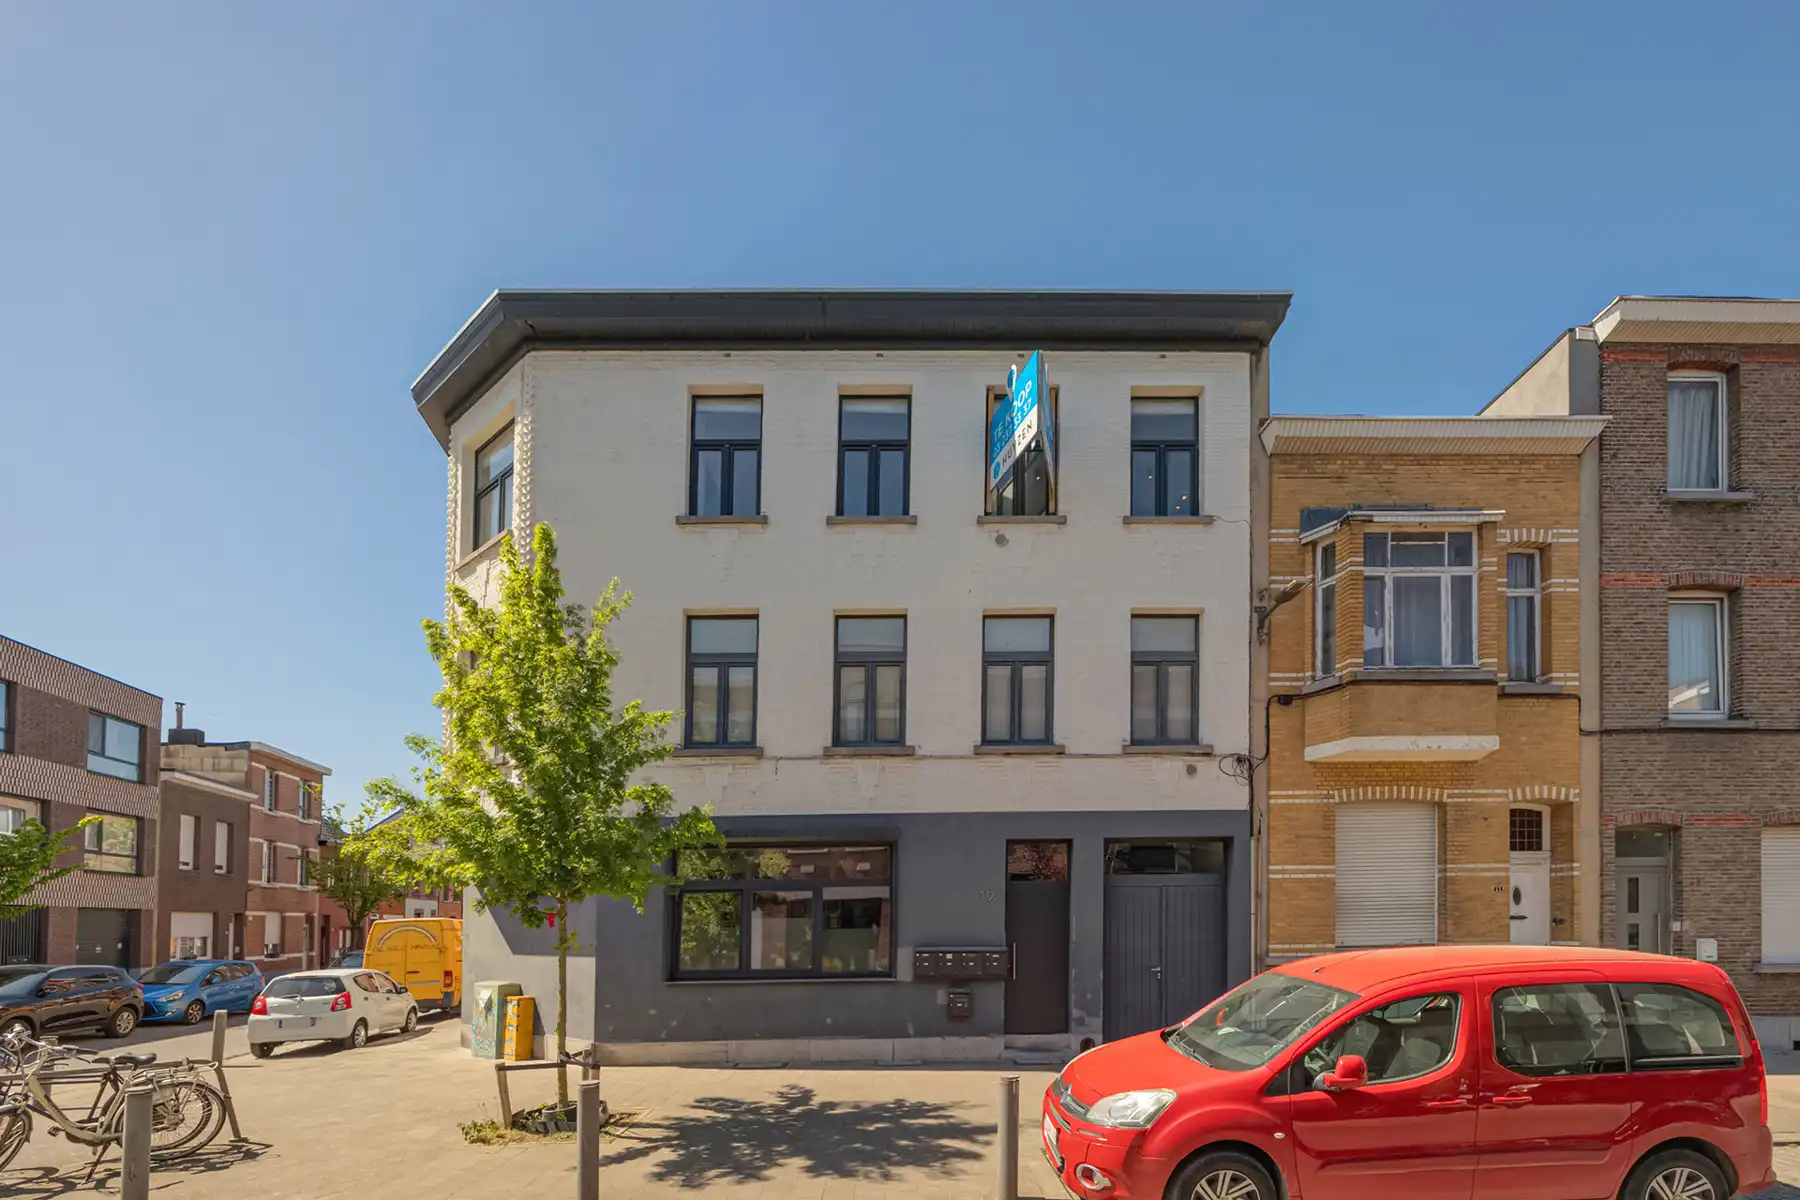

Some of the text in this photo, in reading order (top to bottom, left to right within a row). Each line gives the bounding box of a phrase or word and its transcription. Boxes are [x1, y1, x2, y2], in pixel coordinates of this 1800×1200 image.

[994, 380, 1032, 441] TE KOOP
[1024, 397, 1032, 416] 37
[1002, 420, 1032, 466] HUYZEN
[980, 890, 995, 902] 19
